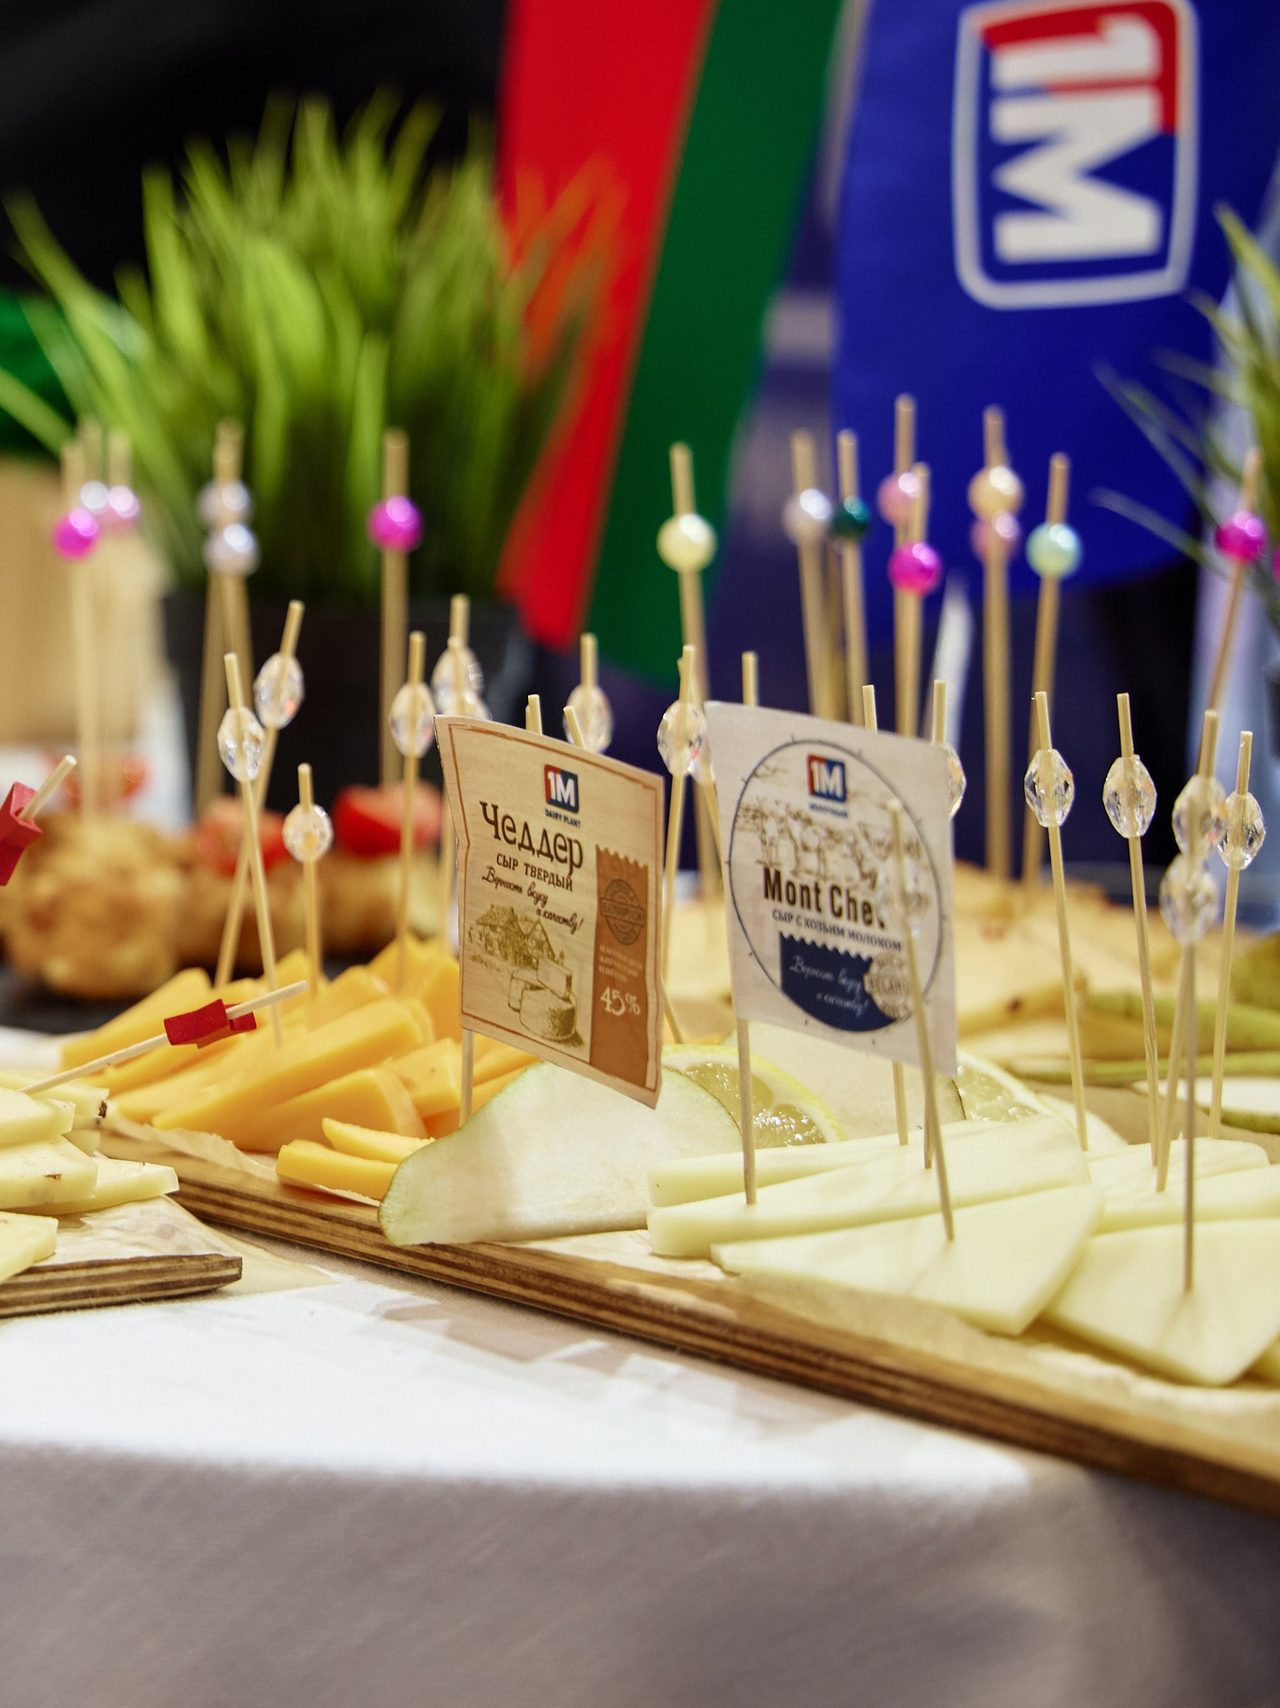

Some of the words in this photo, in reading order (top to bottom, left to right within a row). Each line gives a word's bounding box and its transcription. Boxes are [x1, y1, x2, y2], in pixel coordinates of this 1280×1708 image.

[479, 800, 583, 877] Чеддер
[545, 808, 562, 821] DAIRY
[563, 814, 581, 828] PLANT
[496, 853, 519, 871] СЫР
[523, 862, 573, 892] ТВЕРДЫЙ
[763, 866, 822, 913] Mont
[772, 908, 794, 924] СЫР
[847, 930, 902, 953] МОЛОКОМ
